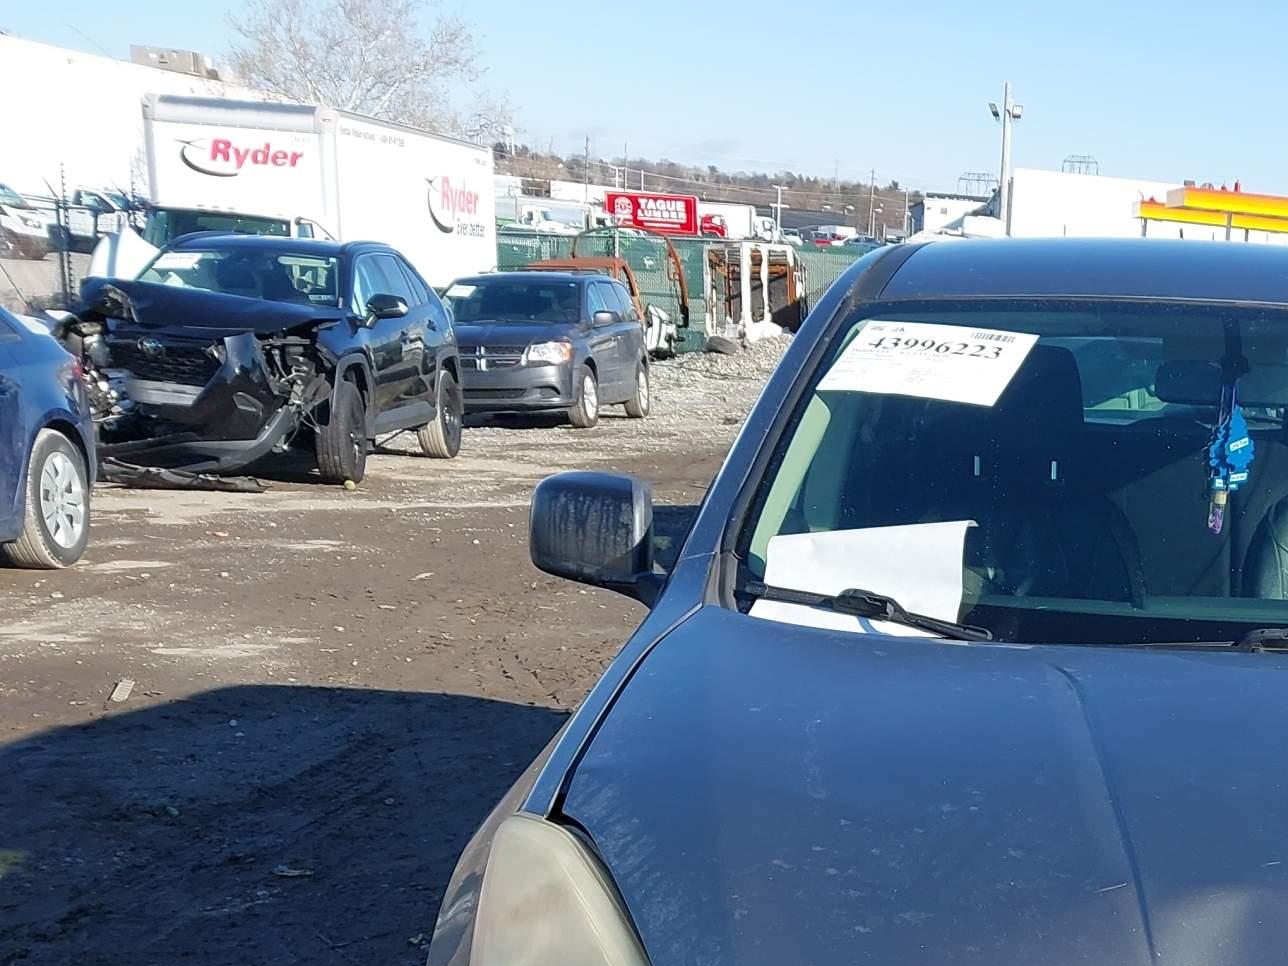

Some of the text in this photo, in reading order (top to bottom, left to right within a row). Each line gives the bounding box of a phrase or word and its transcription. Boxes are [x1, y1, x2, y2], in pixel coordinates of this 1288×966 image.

[209, 138, 304, 169] Ryder
[441, 175, 479, 220] Ryder
[637, 198, 686, 212] TAGUE
[637, 208, 687, 220] LUMBER
[868, 336, 1004, 360] 43996223
